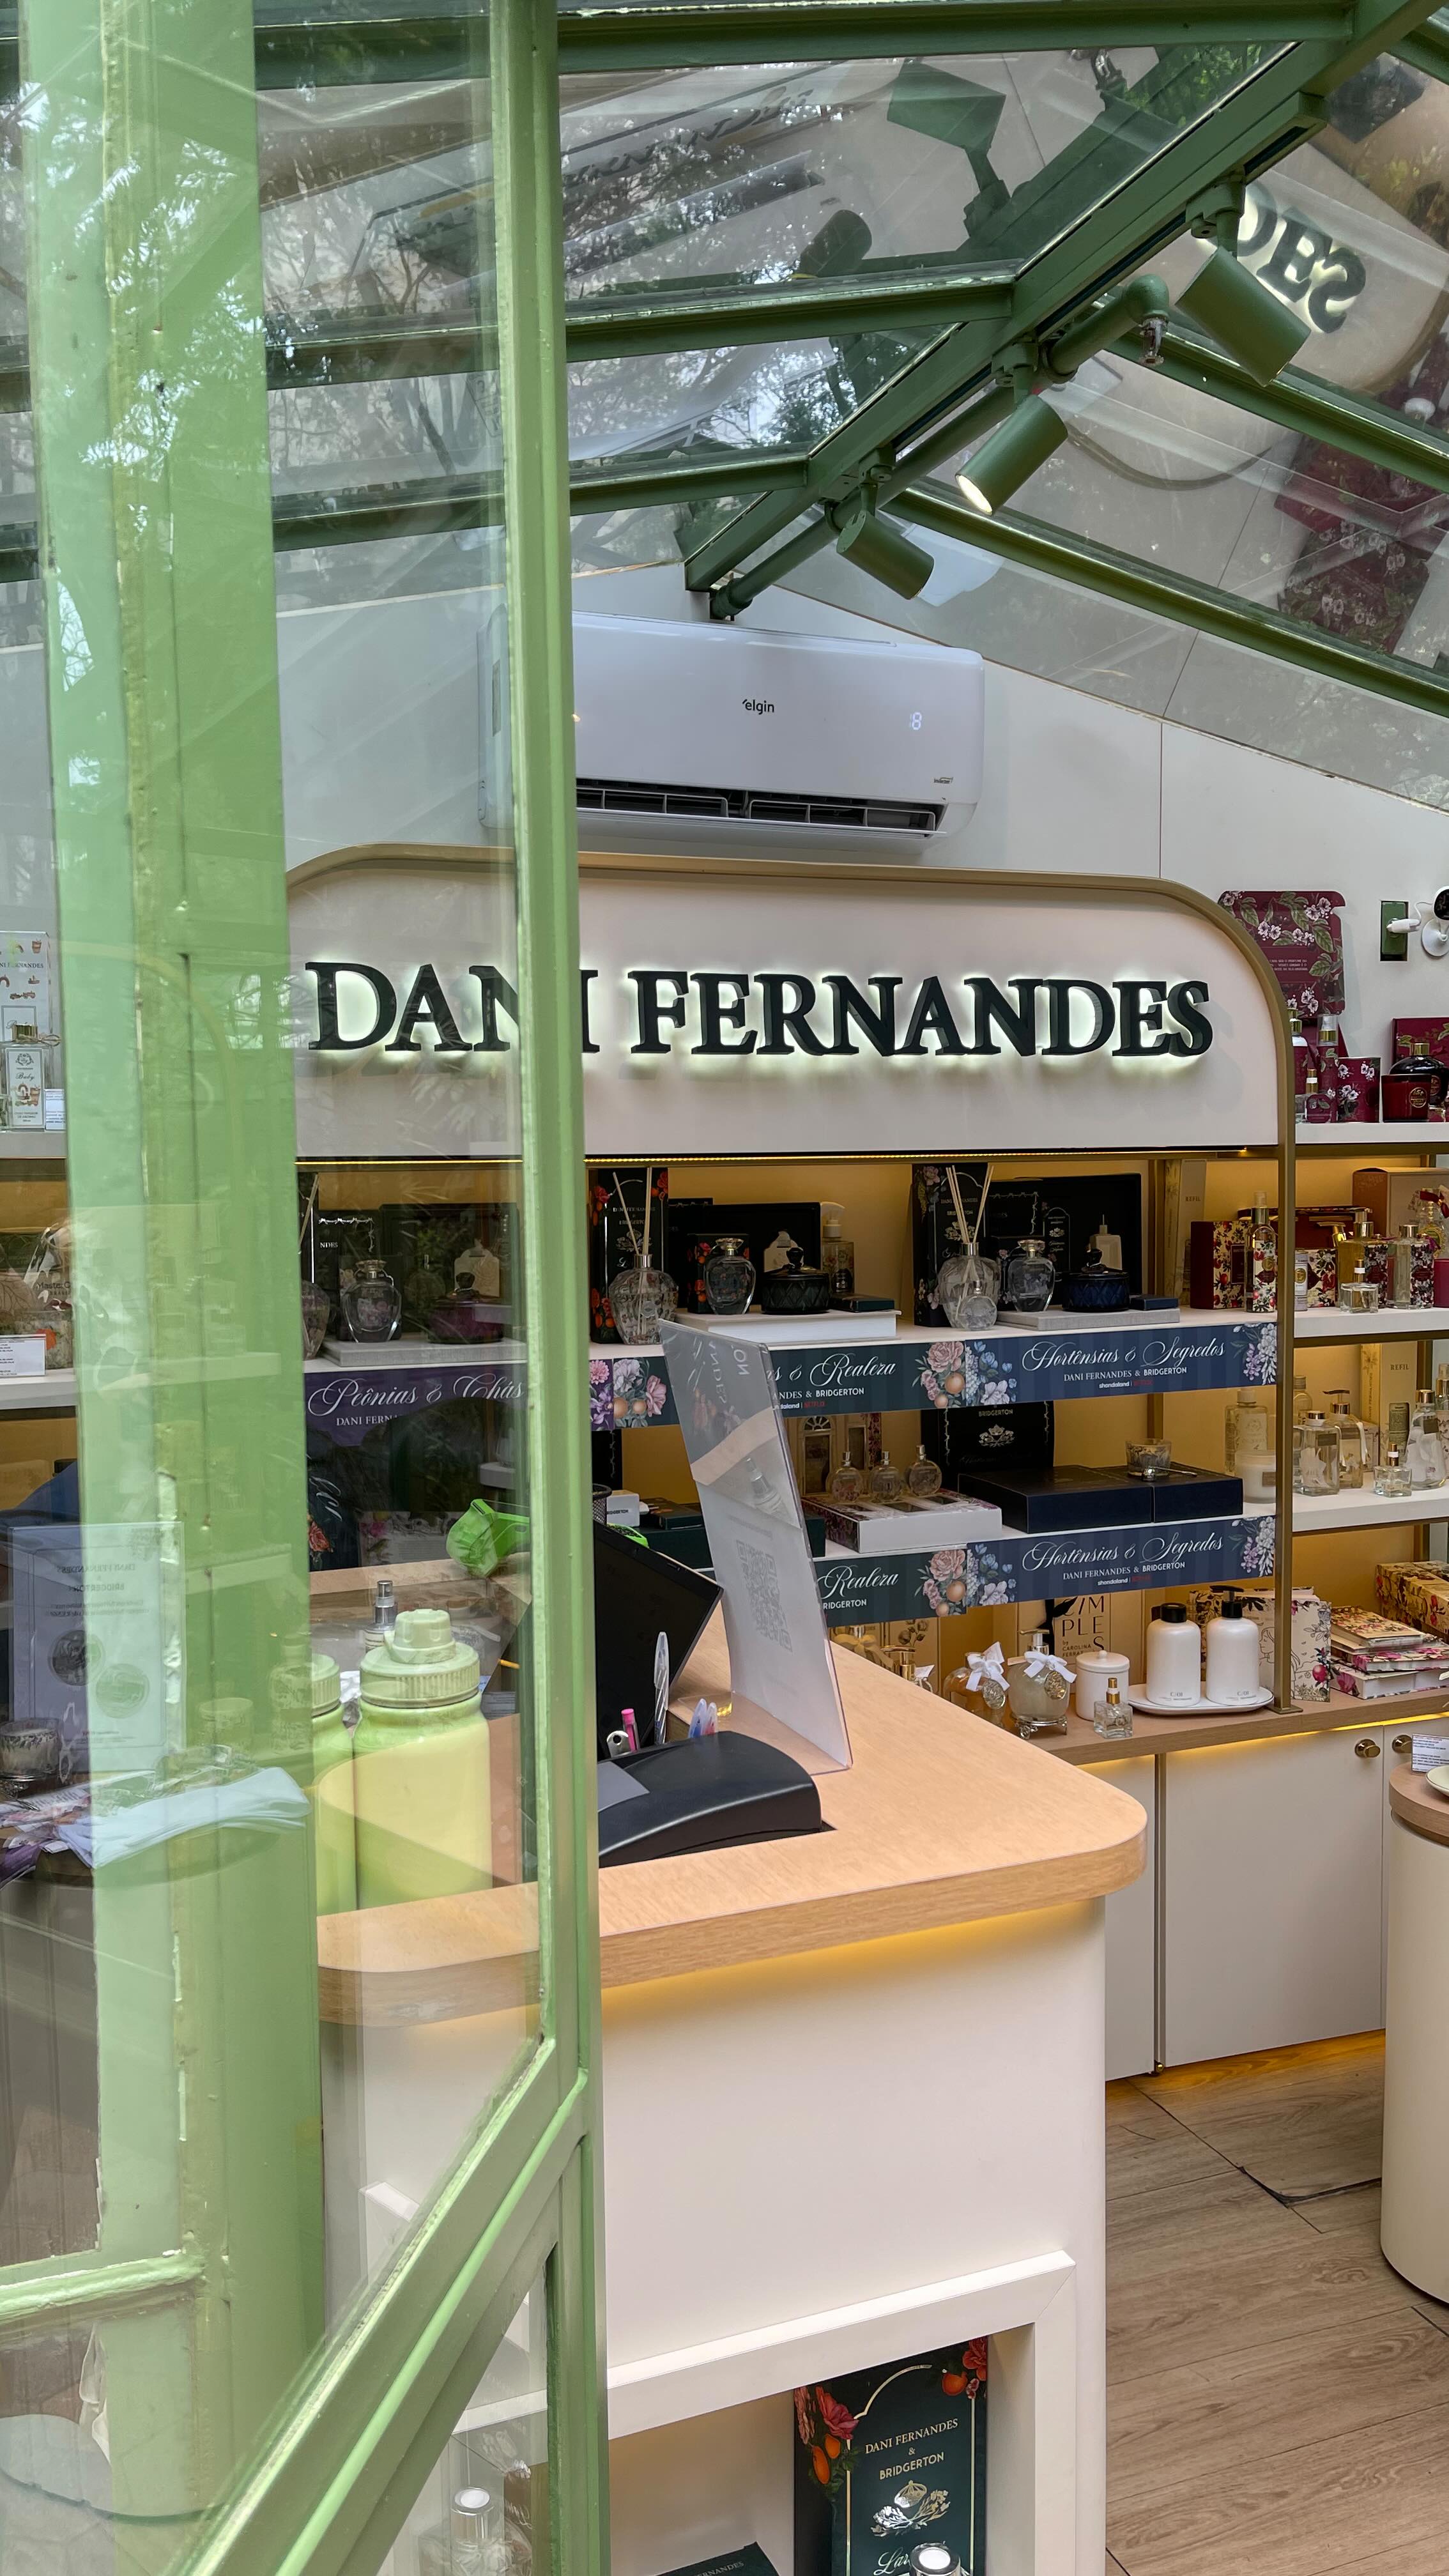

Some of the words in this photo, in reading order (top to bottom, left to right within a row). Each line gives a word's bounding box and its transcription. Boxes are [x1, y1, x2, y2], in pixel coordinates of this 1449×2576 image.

[742, 699, 775, 715] elgin
[627, 970, 1213, 1057] FERNANDES
[1022, 1340, 1119, 1371] Hortênsias
[1140, 1336, 1226, 1367] Segredos
[809, 1353, 896, 1386] Realeza
[1064, 1373, 1084, 1382] DANI
[1085, 1370, 1133, 1381] FERNANDES
[1144, 1367, 1187, 1376] BRIDGERTON
[308, 1377, 419, 1416] Peônias
[454, 1373, 525, 1400] Chás
[815, 1388, 864, 1398] BRIDGERTON
[337, 1417, 362, 1427] DANI
[978, 1409, 1013, 1417] BRIDGERTON
[1022, 1541, 1119, 1571] Hortênsias
[1140, 1532, 1223, 1563] Segredos
[817, 1565, 899, 1600] Realeza
[1063, 1572, 1083, 1581] DANI
[1084, 1567, 1131, 1579] FERNANDES
[1142, 1561, 1185, 1572] BRIDGERTON
[865, 2437, 893, 2454] DANI
[895, 2418, 958, 2446] FERNANDES
[879, 2451, 944, 2480] BRIDGERTON
[908, 2447, 916, 2456] &
